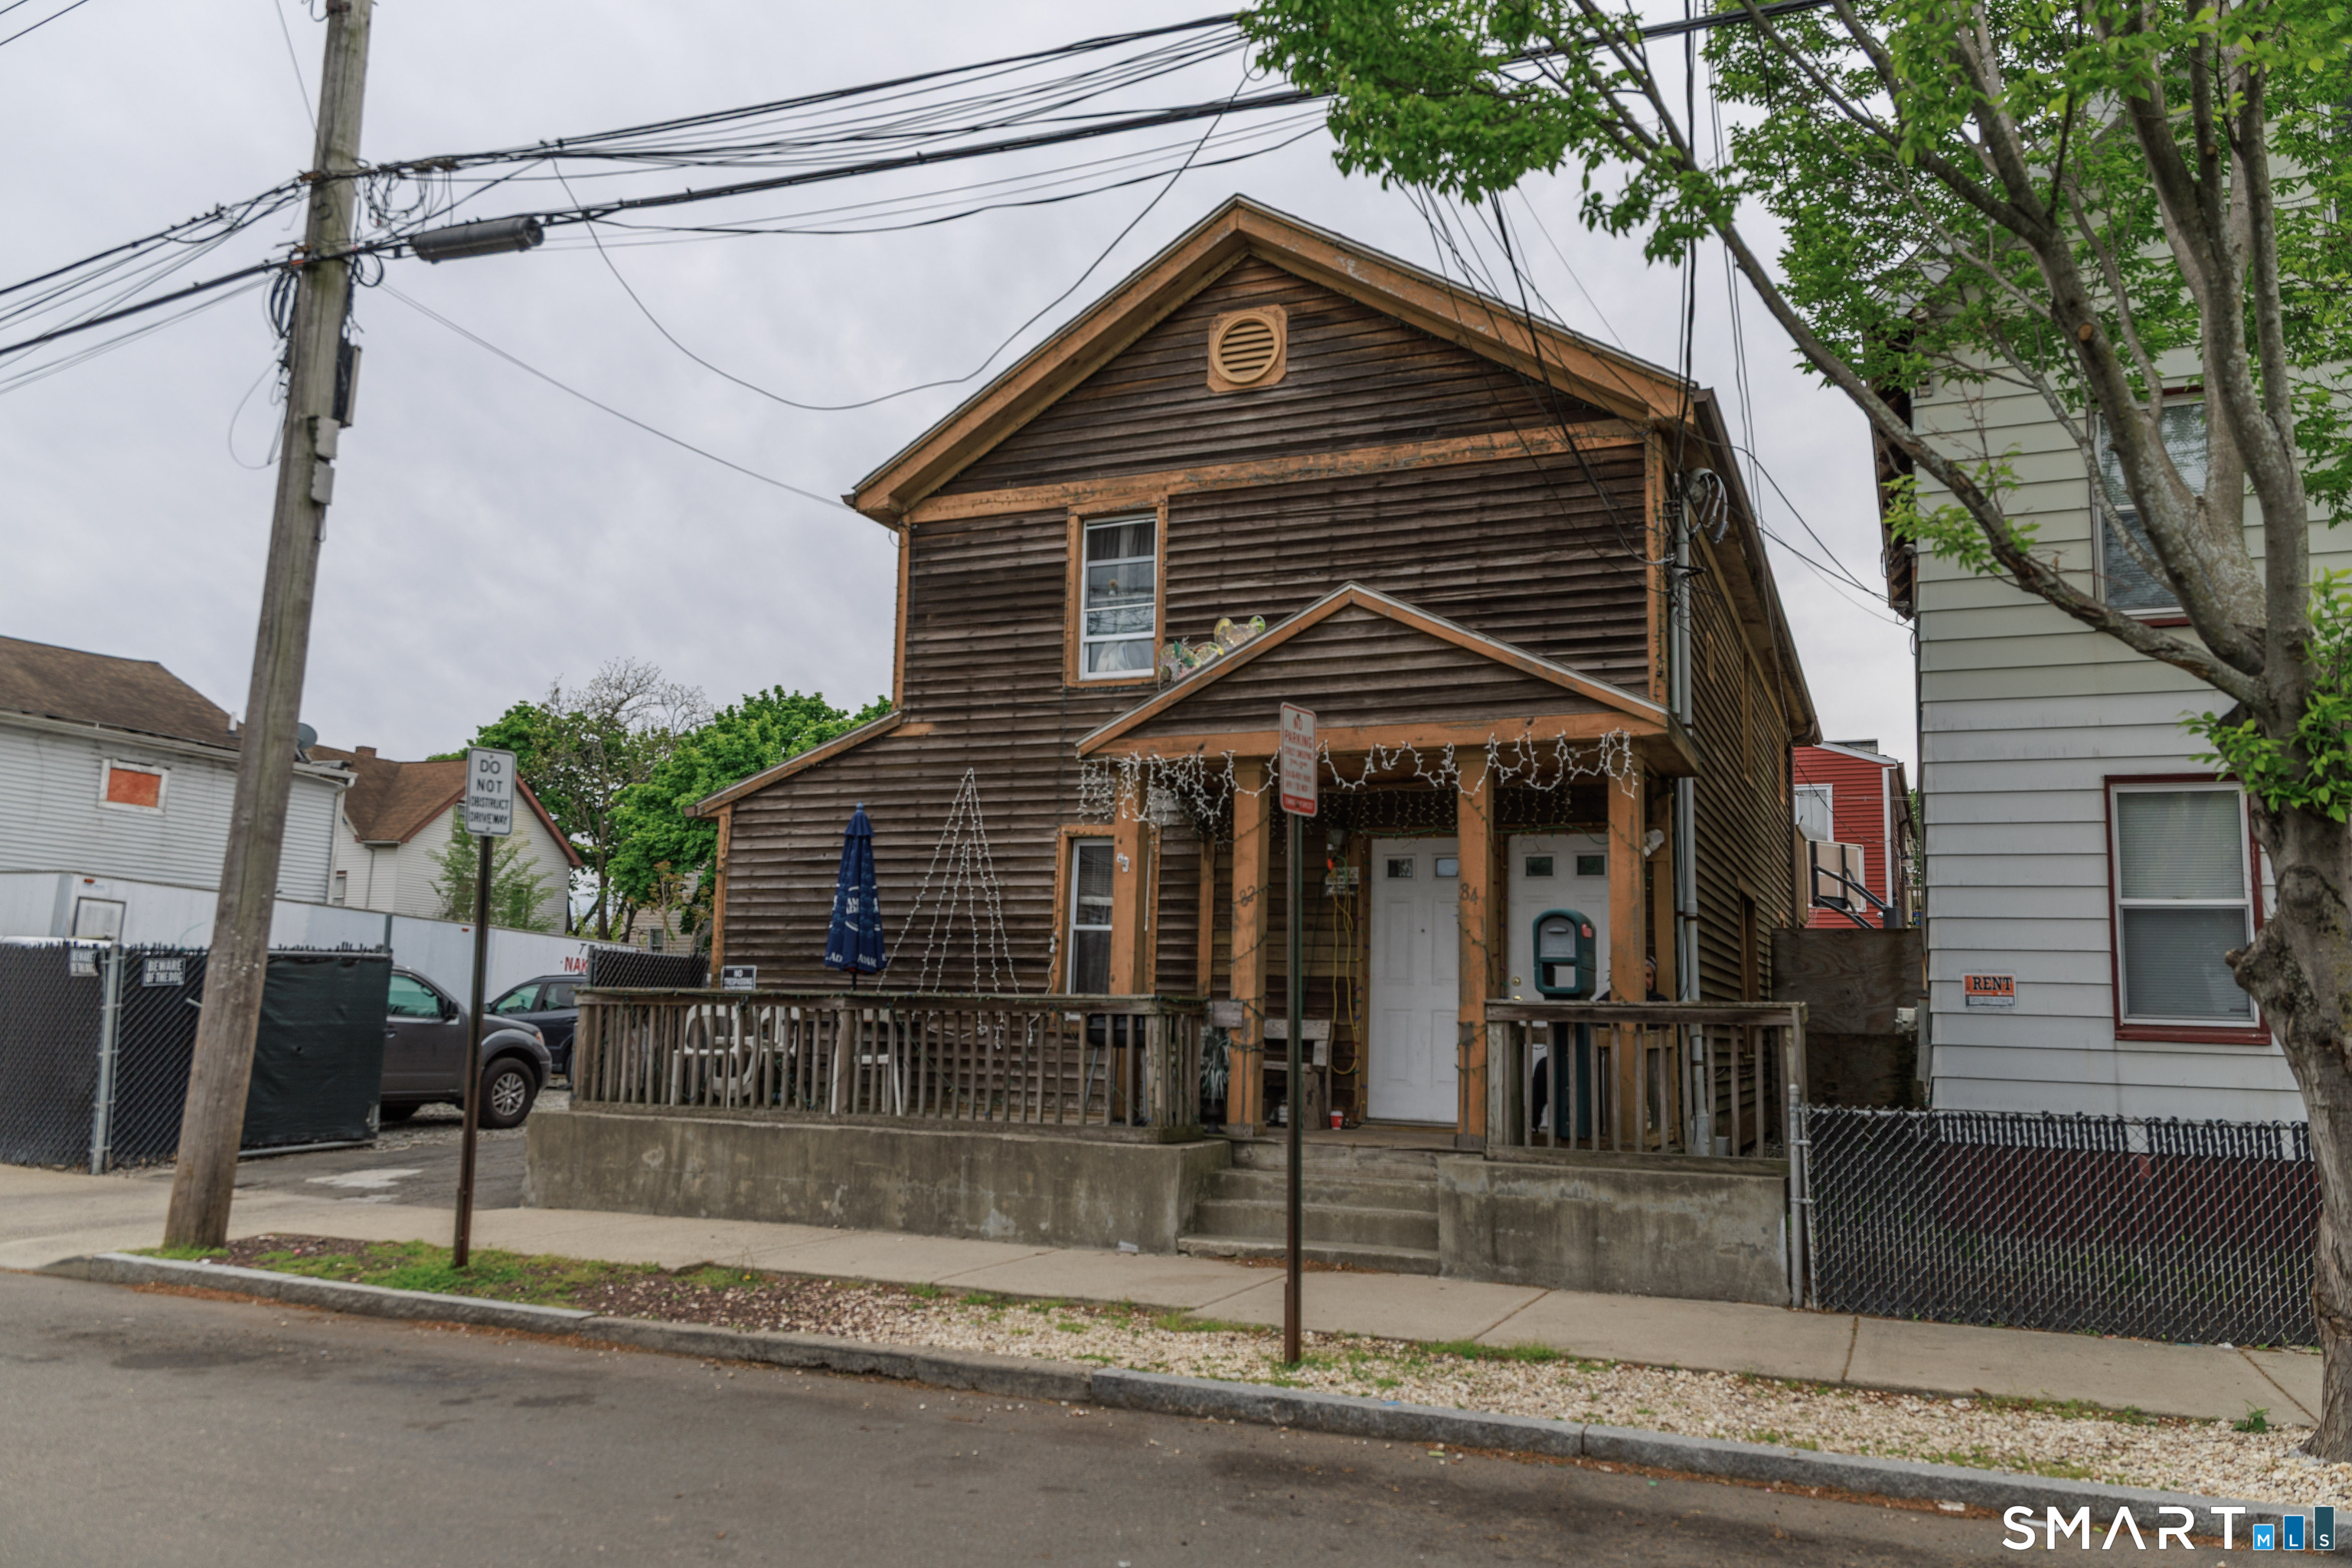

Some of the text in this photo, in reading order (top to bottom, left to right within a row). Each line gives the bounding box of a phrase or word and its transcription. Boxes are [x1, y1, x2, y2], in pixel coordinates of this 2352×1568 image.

[1293, 717, 1303, 730] NO
[1285, 729, 1313, 749] PARKING
[480, 759, 501, 774] DO
[476, 778, 503, 793] NOT
[470, 795, 509, 810] OBSTRUCT
[469, 811, 508, 825] DRIVEWAY
[1239, 885, 1256, 906] 82
[1460, 882, 1478, 905] 84
[147, 959, 183, 972] BEWARE
[146, 971, 183, 984] OF THE DOG
[733, 969, 743, 978] NO
[1972, 976, 2012, 991] RENT
